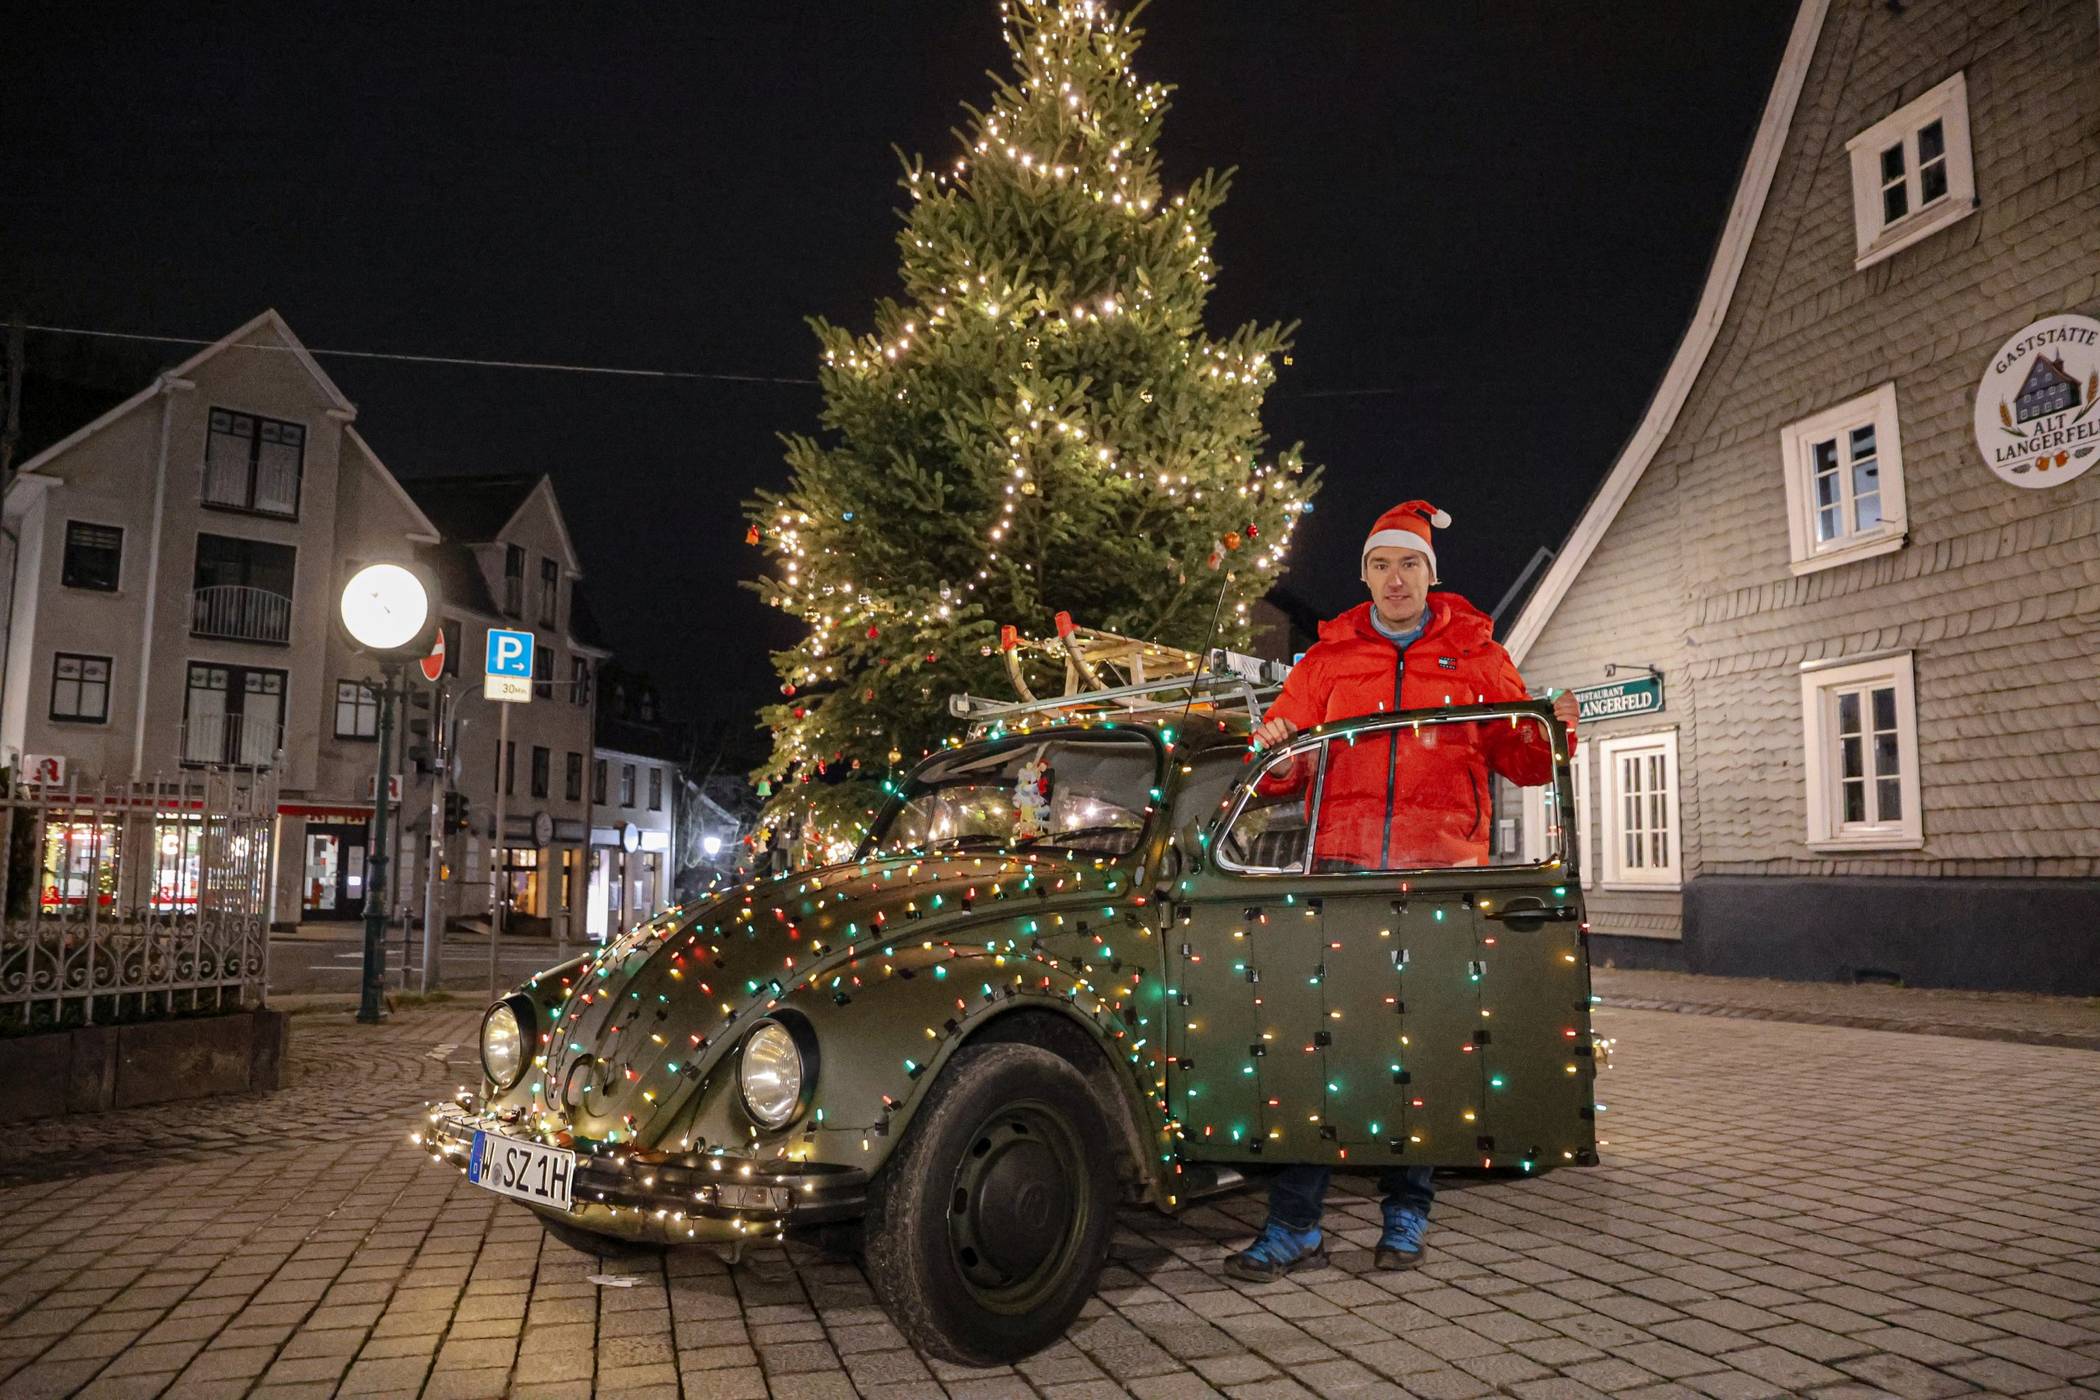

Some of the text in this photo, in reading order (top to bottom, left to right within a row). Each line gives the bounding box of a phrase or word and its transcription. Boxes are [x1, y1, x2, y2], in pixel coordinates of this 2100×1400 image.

[1995, 325, 2099, 374] GASTSTÄTTE
[1996, 418, 2100, 463] LANGERFEL
[2034, 414, 2067, 435] ALT
[496, 636, 523, 670] P
[480, 1139, 496, 1181] W
[503, 1147, 533, 1193] SZ
[535, 1155, 570, 1202] 1H
